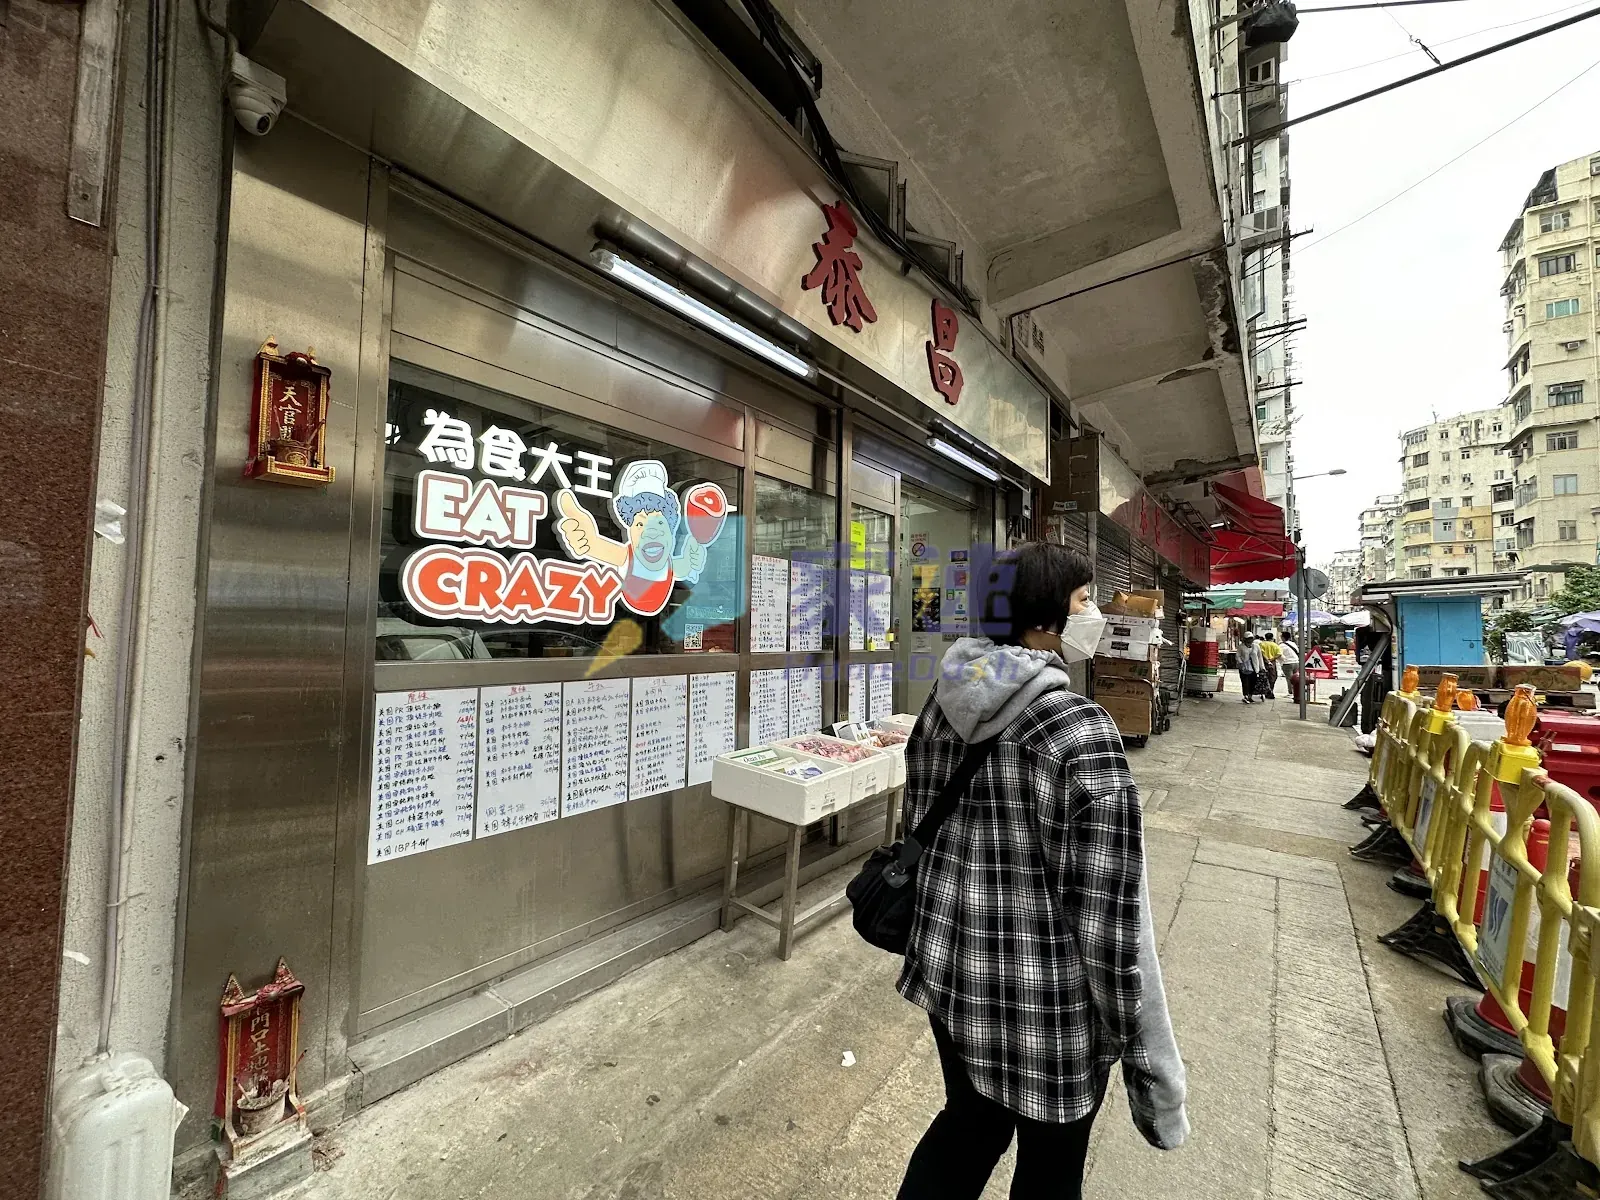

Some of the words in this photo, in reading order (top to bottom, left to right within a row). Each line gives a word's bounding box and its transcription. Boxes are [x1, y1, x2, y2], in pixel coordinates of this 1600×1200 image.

[801, 200, 964, 406] 泰昌
[417, 408, 613, 498] 為食大王
[416, 471, 547, 548] EAT
[404, 547, 621, 623] CRAZY
